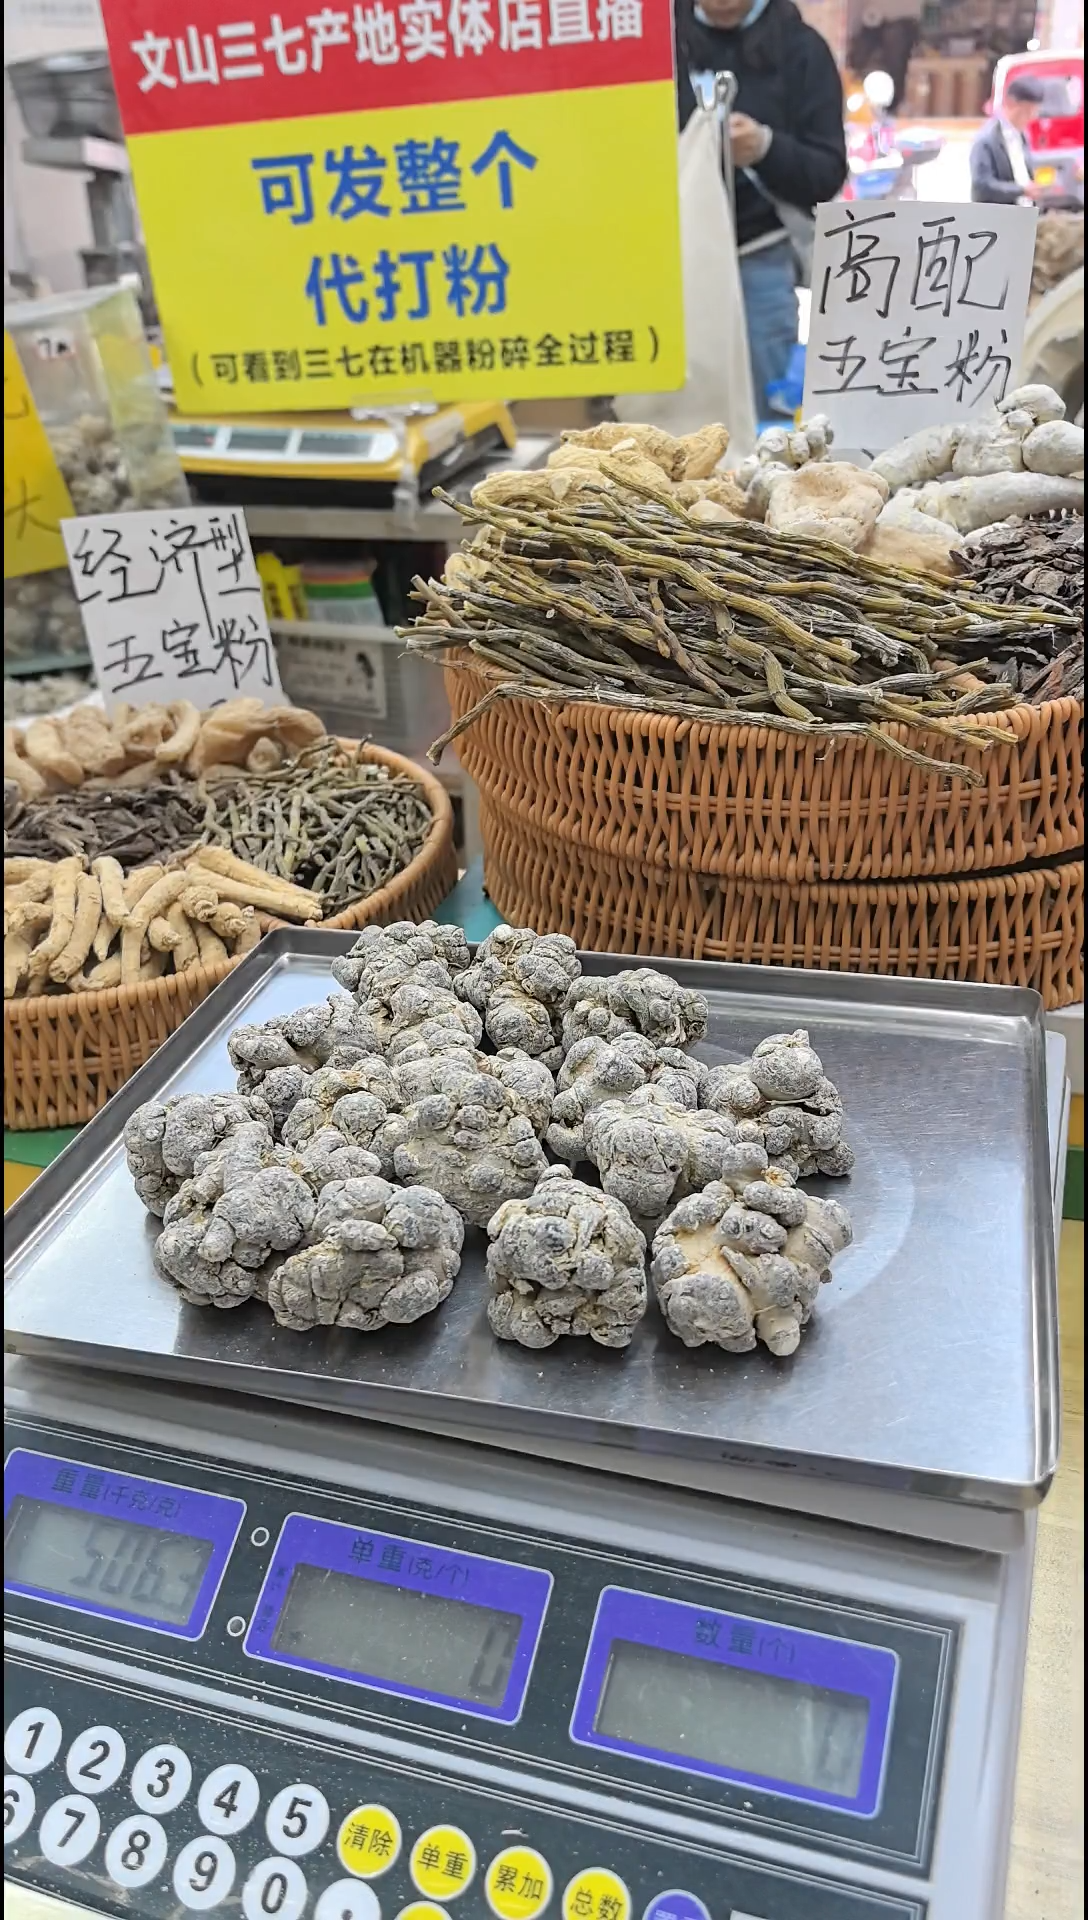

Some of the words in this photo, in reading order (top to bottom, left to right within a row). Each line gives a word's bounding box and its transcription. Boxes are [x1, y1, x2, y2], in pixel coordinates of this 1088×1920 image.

[131, 0, 643, 92] 文山三七产地实体店直播
[251, 130, 538, 226] 可发整个
[305, 243, 511, 327] 代打粉
[819, 209, 1009, 318] 高配
[812, 327, 1012, 408] 五宝粉
[72, 513, 261, 638] 经济型
[104, 616, 274, 693] 五宝粉
[24, 1721, 45, 1759] 1
[79, 1740, 111, 1780] 2
[147, 1758, 176, 1798] 3
[214, 1780, 241, 1819] 4
[282, 1797, 312, 1839] 5
[344, 1822, 394, 1857] 清除
[417, 1843, 468, 1881] 单重
[494, 1864, 544, 1901] 累加
[57, 1808, 86, 1847] 7
[121, 1829, 150, 1871] 8
[189, 1851, 218, 1891] 9
[261, 1872, 288, 1914] 0
